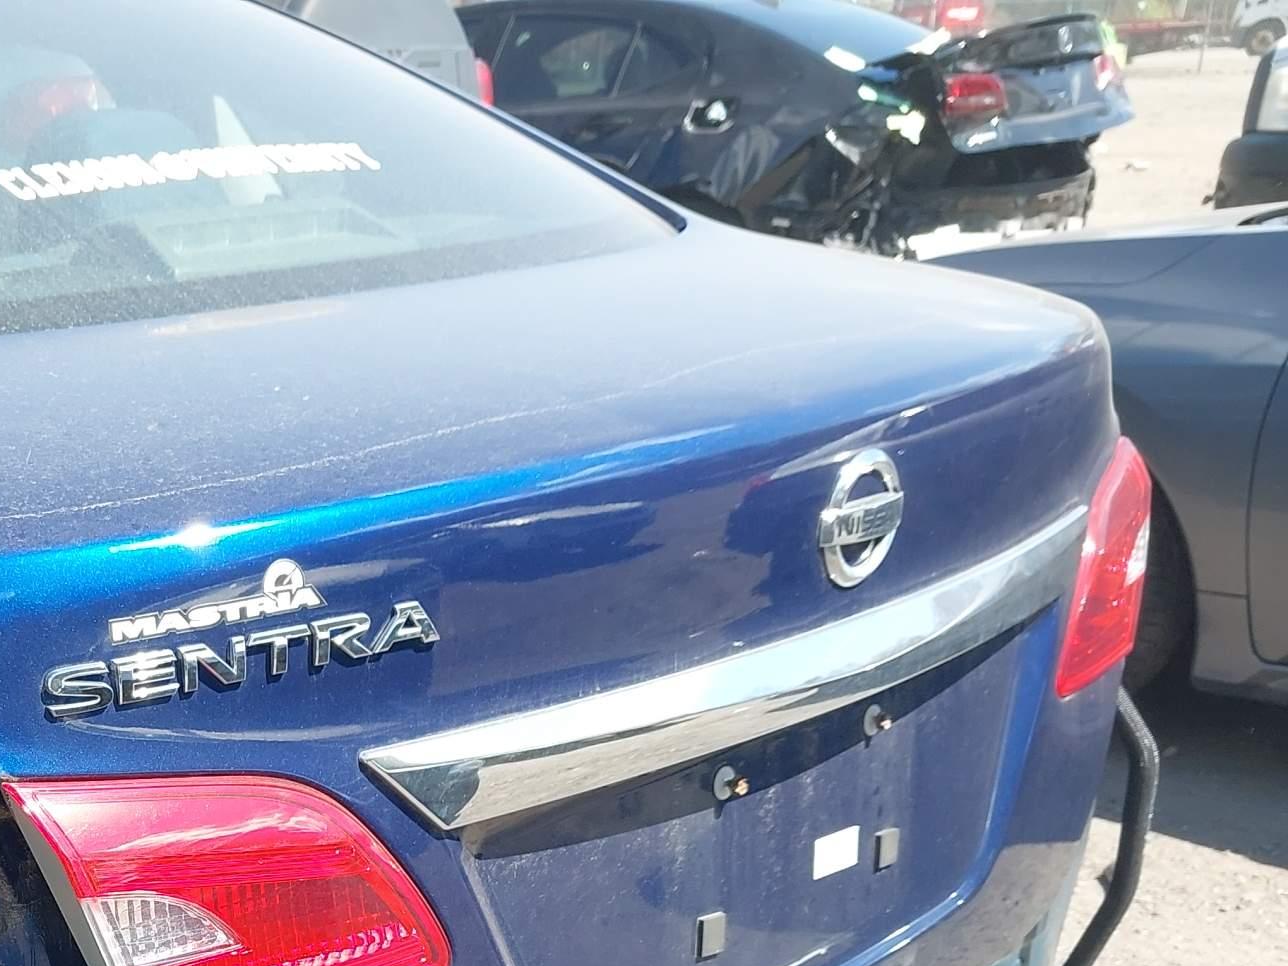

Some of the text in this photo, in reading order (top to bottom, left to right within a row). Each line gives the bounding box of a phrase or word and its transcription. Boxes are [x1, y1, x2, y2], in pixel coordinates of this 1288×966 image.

[834, 501, 900, 541] NISS
[110, 586, 324, 644] MASTRIA
[42, 601, 440, 718] SENTRA
